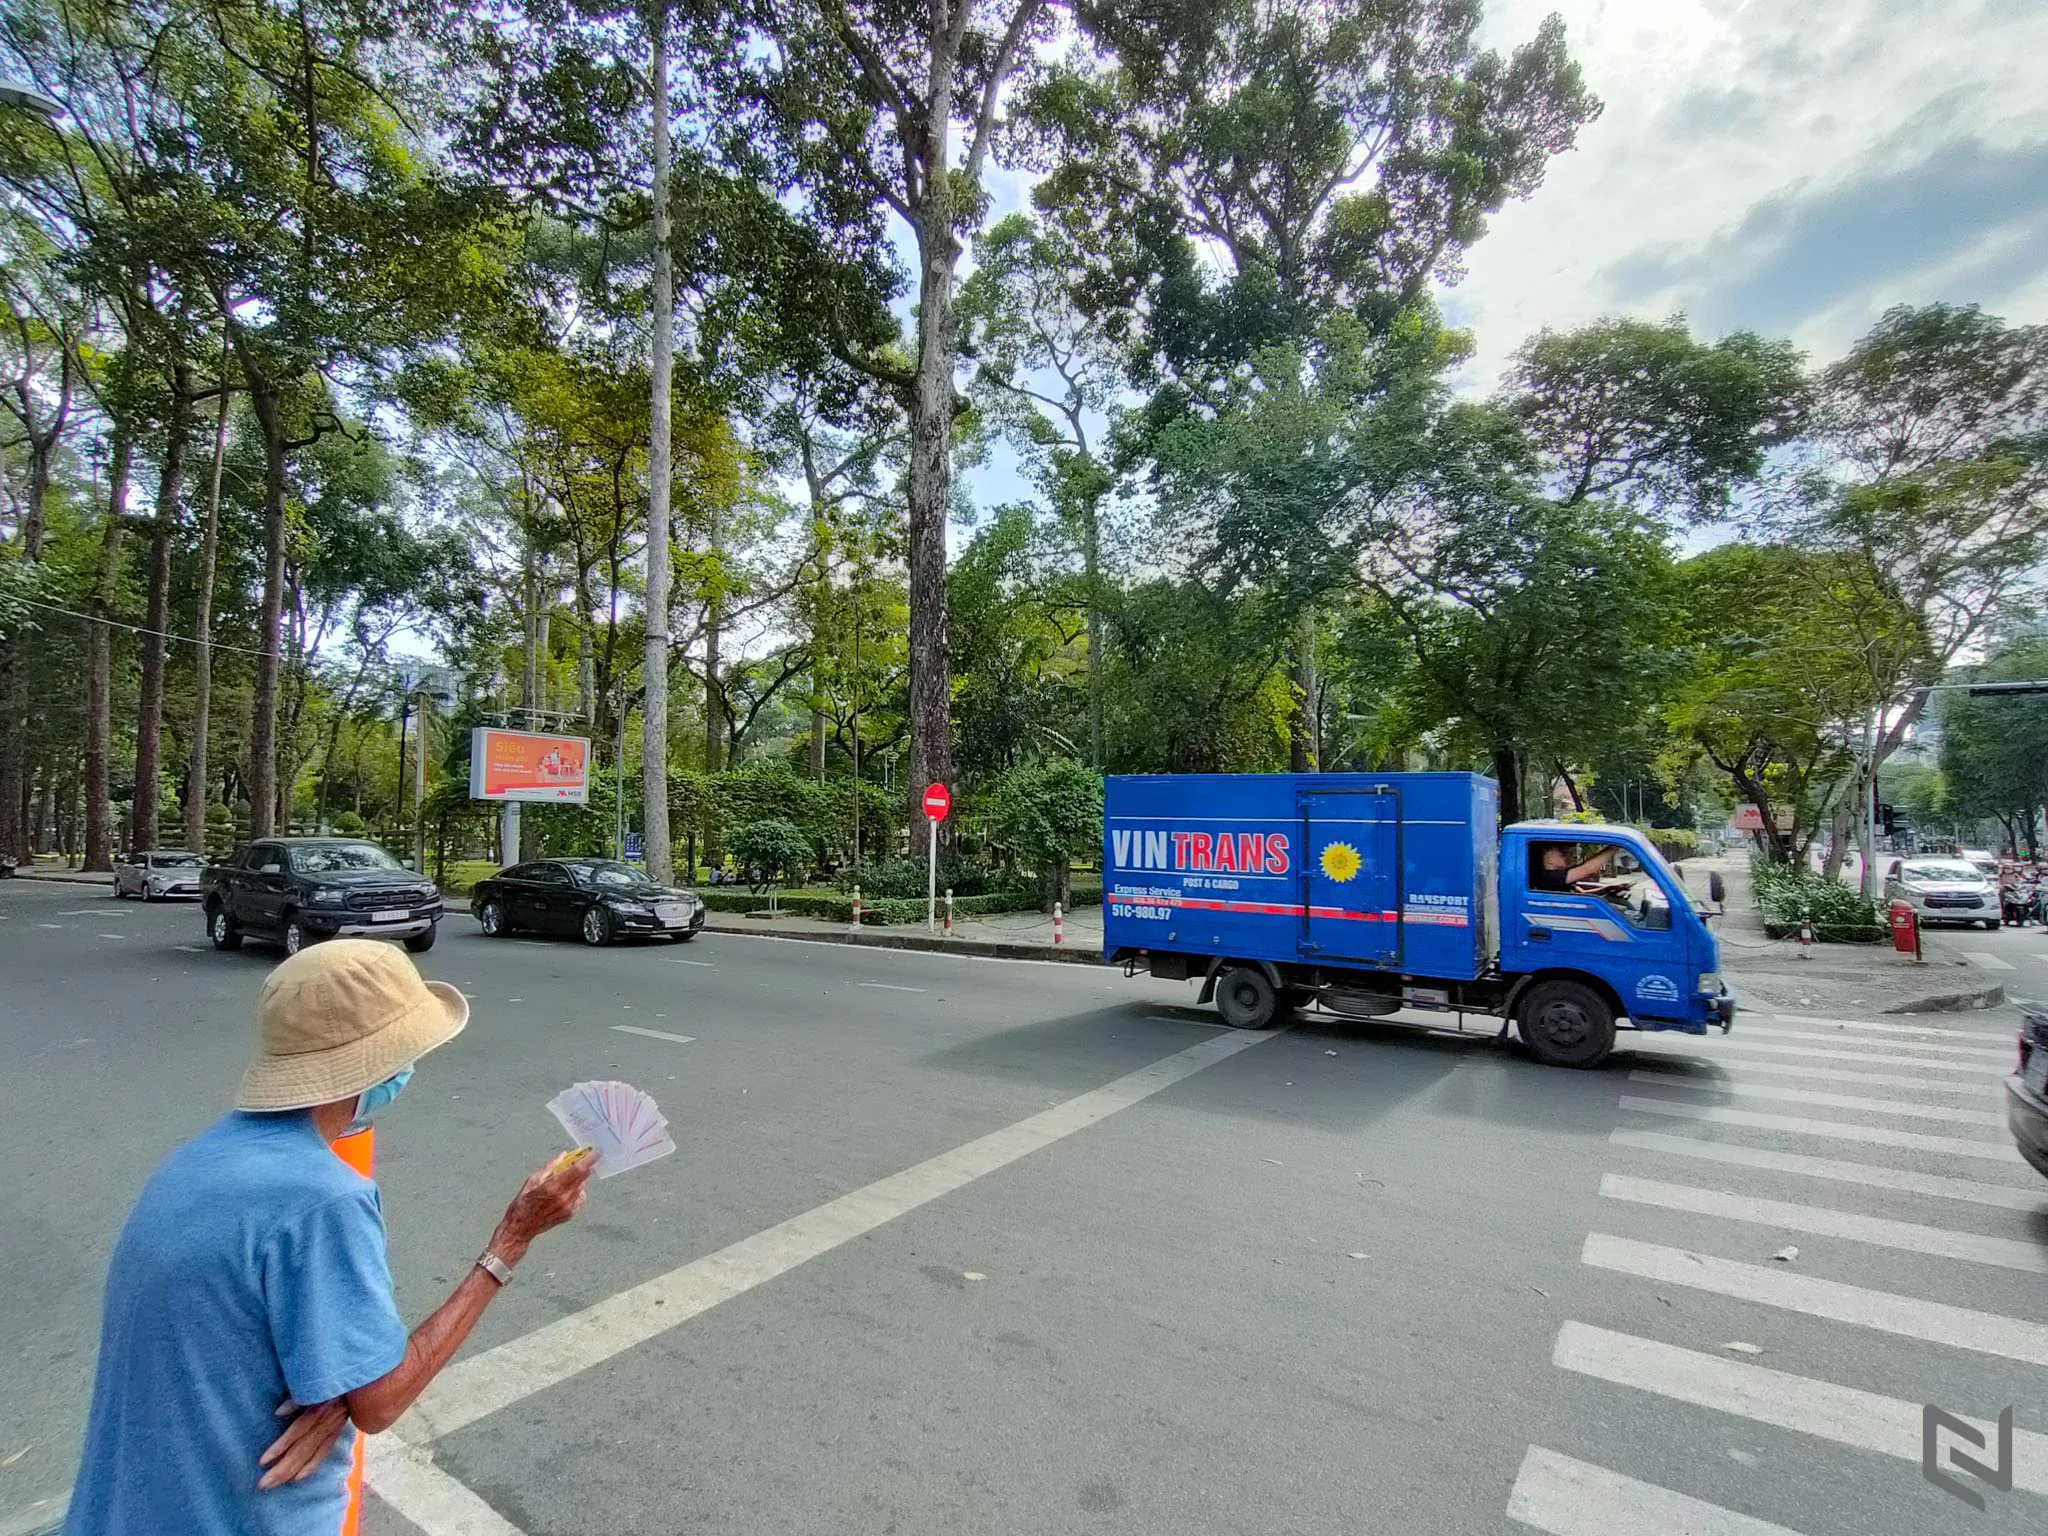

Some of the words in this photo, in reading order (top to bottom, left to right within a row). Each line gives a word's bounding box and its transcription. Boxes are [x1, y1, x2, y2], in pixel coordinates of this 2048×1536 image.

[1114, 883, 1148, 896] Express
[1149, 886, 1182, 897] Service
[1183, 877, 1203, 888] POST
[1212, 879, 1239, 890] CARGO
[1112, 904, 1172, 921] 51C-980.97
